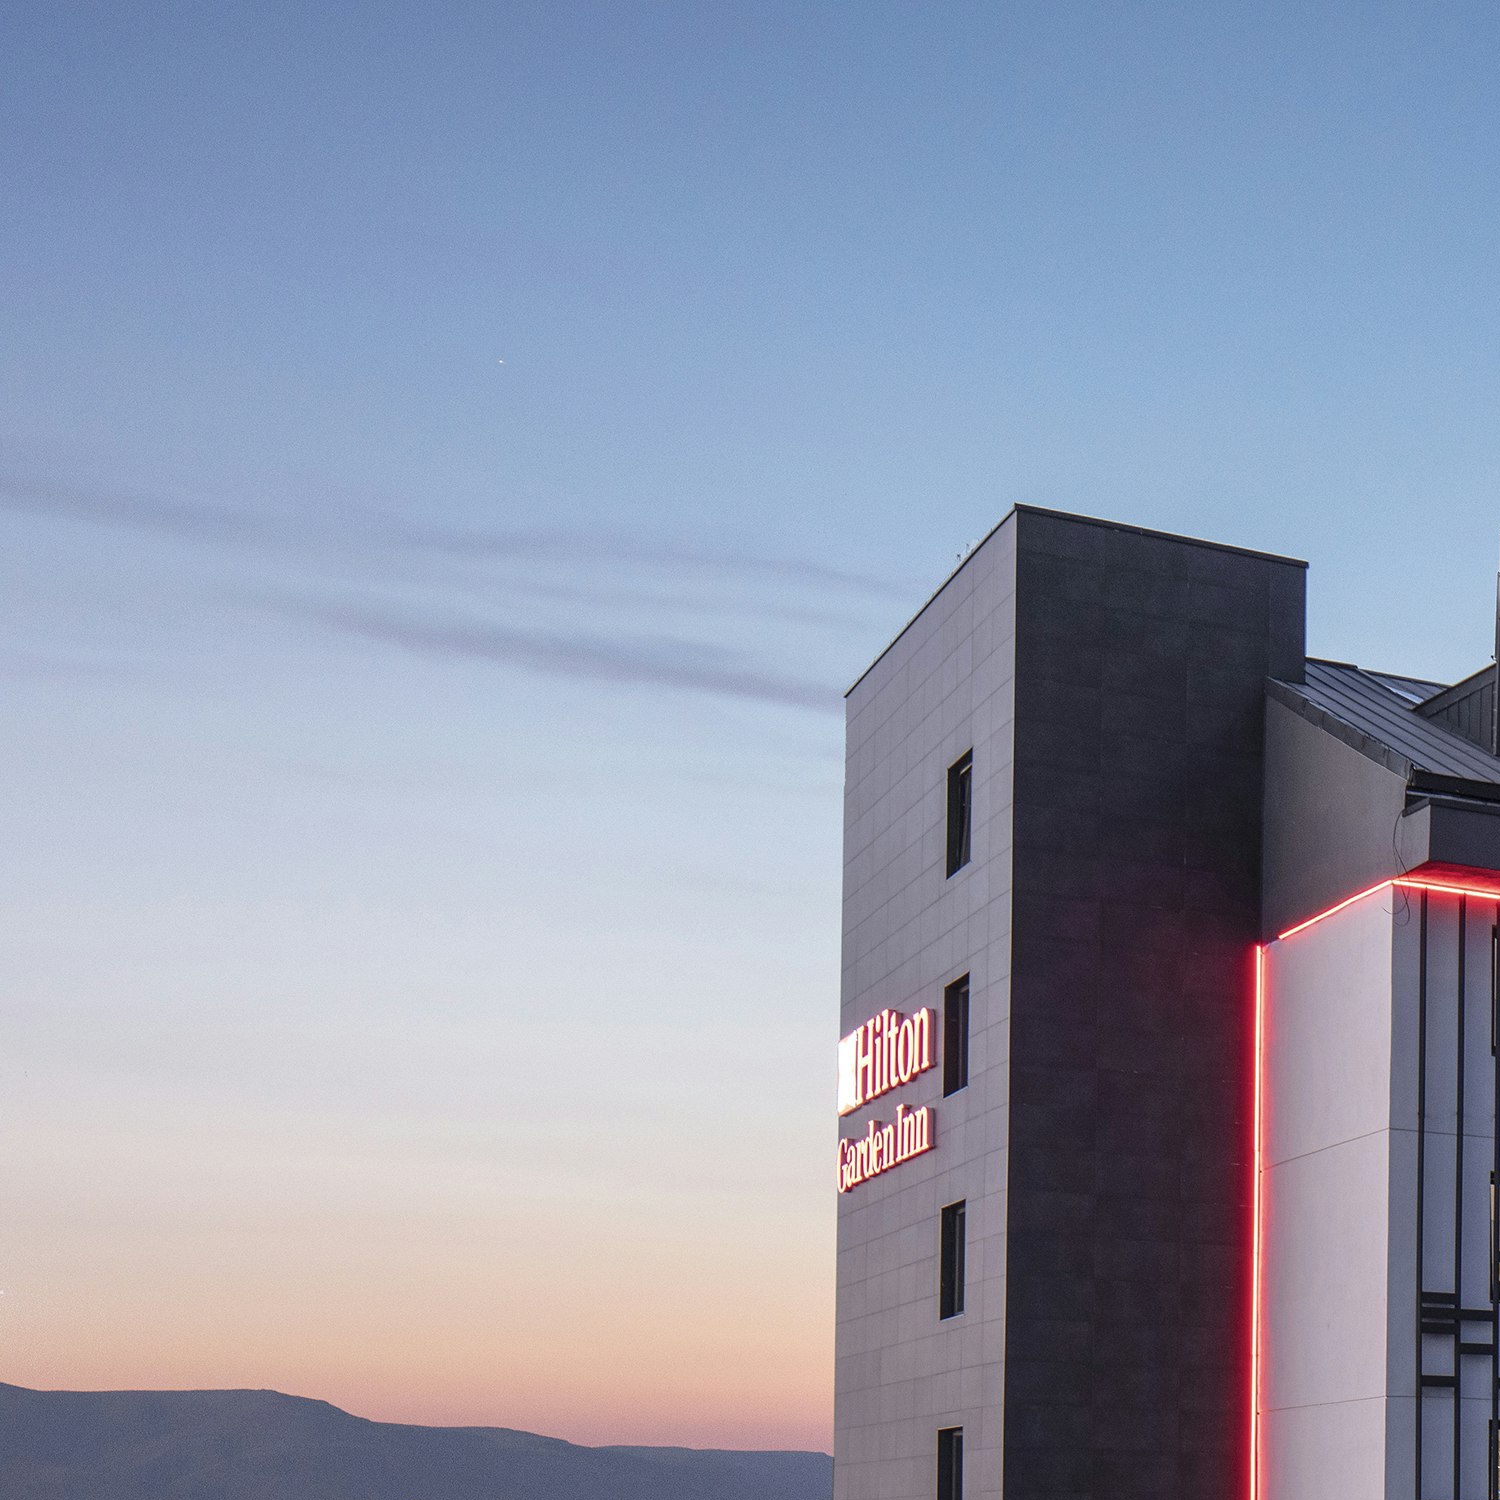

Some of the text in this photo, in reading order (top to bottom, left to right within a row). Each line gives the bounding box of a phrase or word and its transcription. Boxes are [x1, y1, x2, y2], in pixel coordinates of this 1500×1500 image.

[855, 1006, 934, 1107] Hilton
[837, 1103, 933, 1194] Garden Inn
